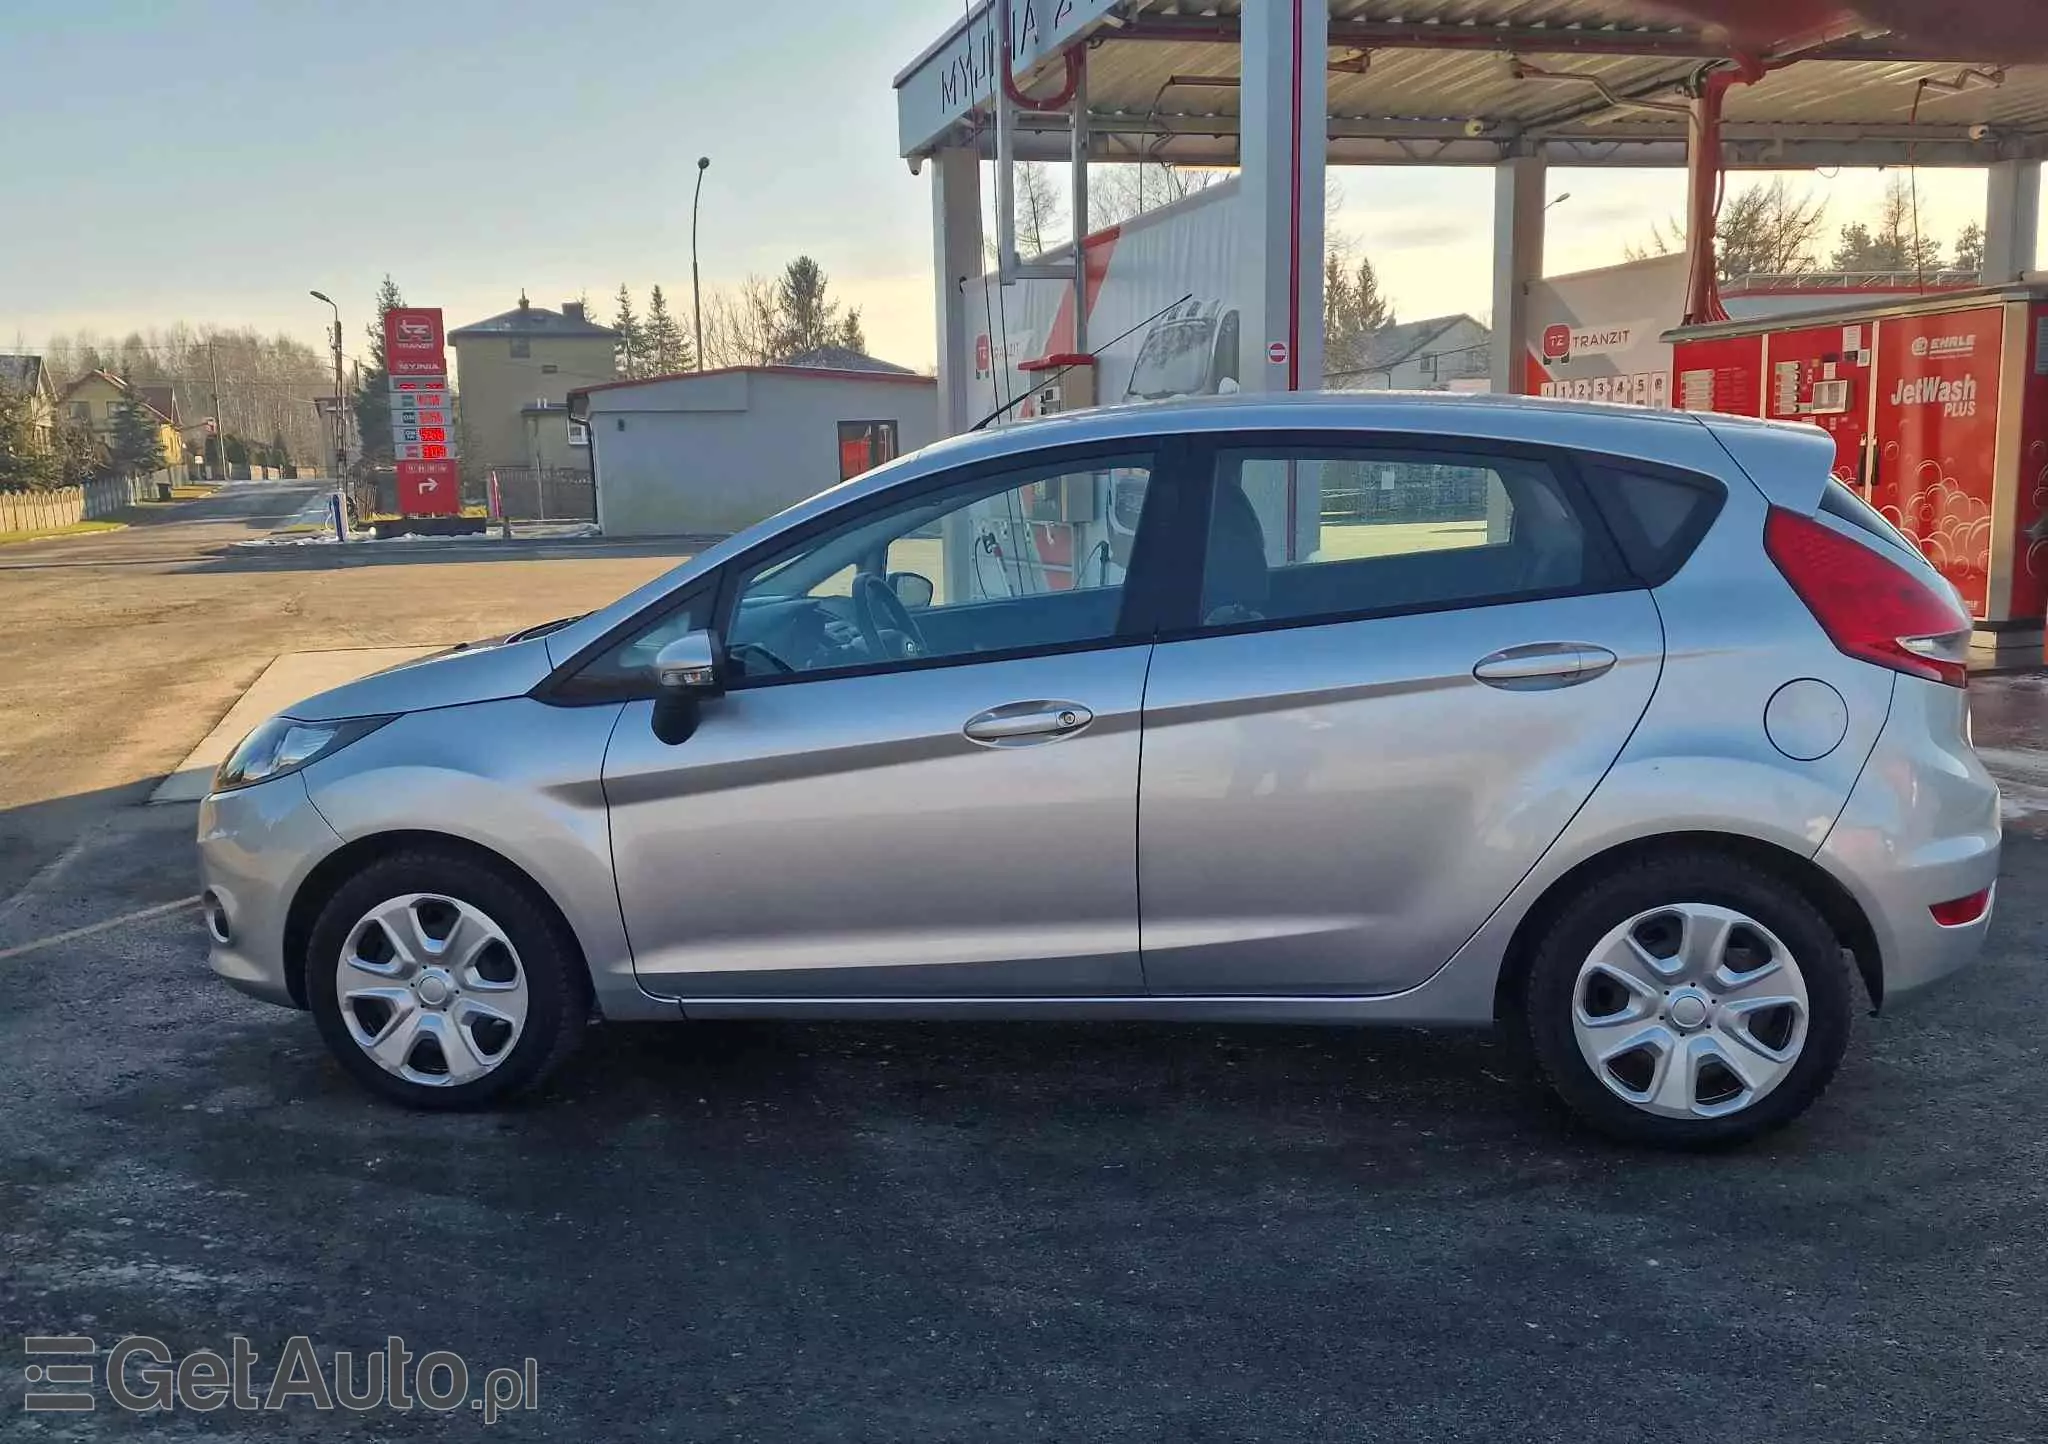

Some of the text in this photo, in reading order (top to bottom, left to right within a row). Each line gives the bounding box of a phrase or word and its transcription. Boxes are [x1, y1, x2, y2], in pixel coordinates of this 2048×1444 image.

[1573, 329, 1631, 349] TRANZIT
[1578, 383, 1585, 396] 2
[1616, 381, 1624, 393] 4
[1890, 373, 1977, 406] JetWash
[1943, 400, 1976, 417] PLUS
